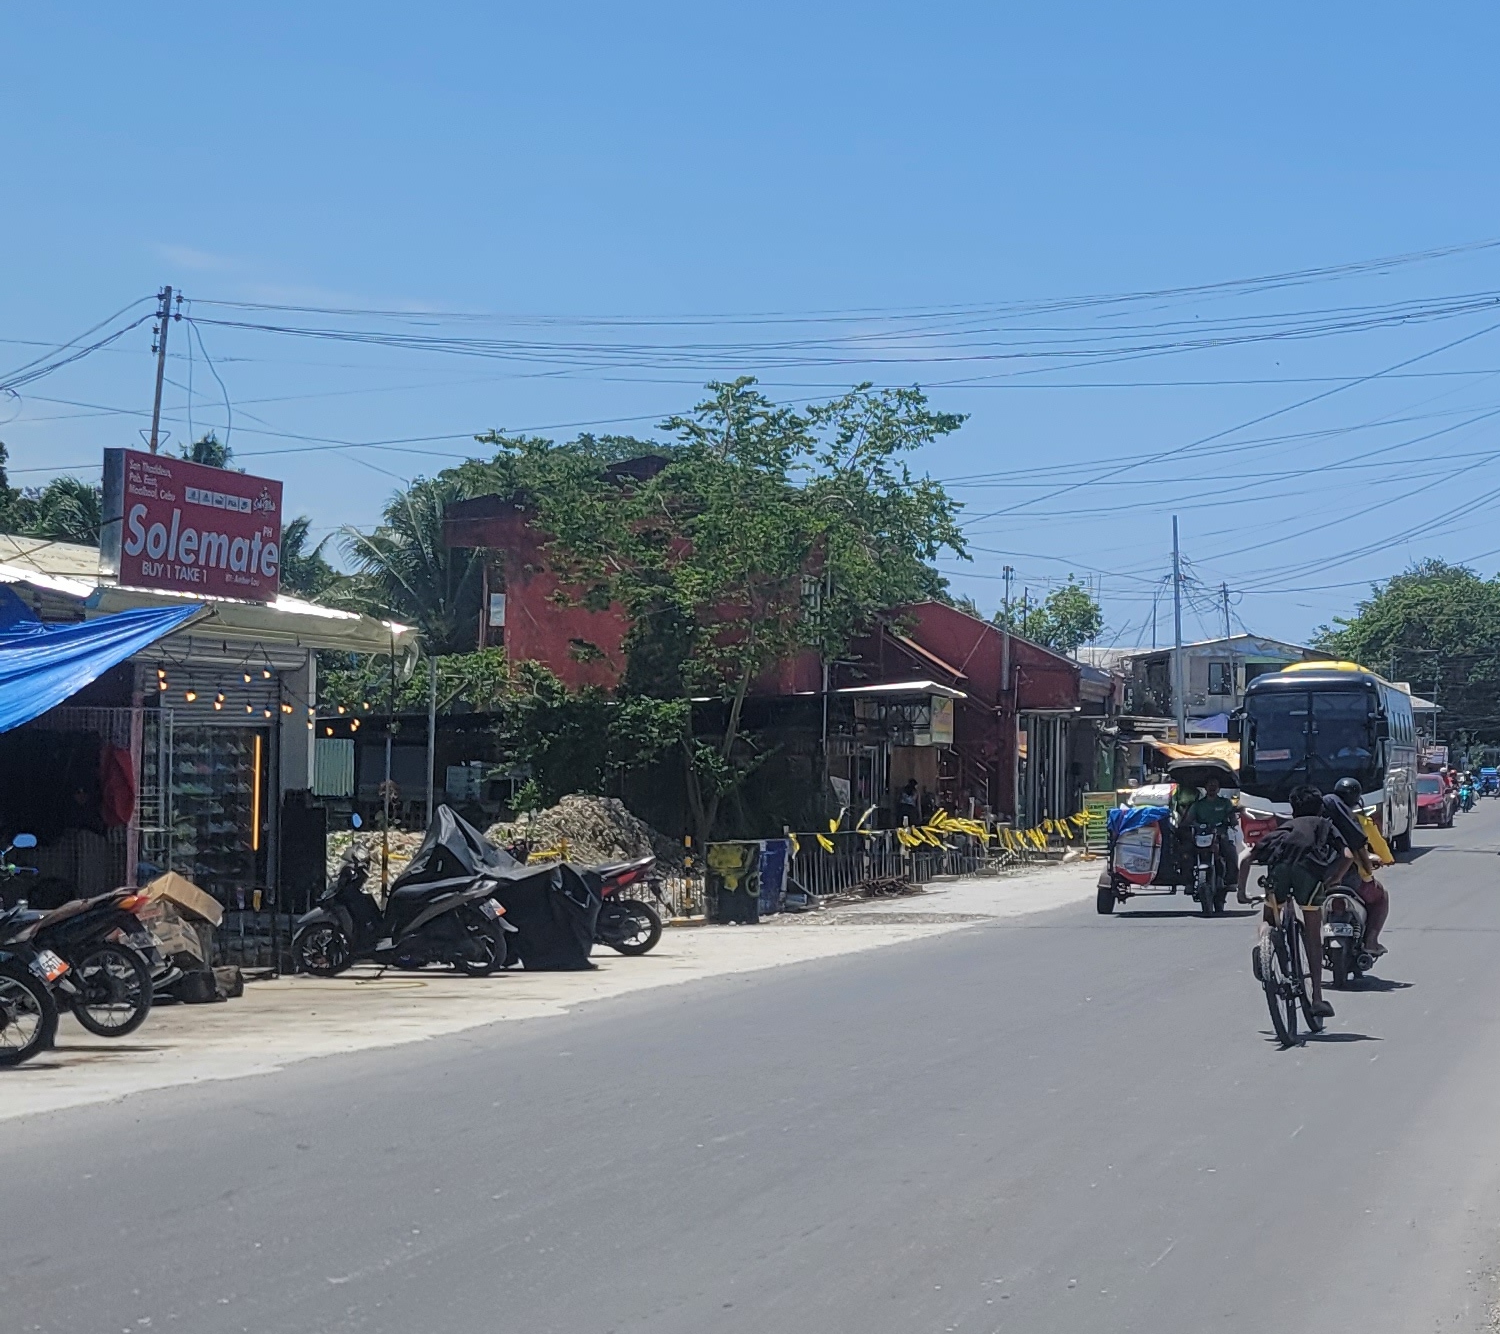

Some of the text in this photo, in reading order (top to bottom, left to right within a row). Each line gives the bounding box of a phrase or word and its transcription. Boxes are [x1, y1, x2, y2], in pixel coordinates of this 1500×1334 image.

[124, 503, 278, 577] Solemate
[142, 561, 207, 584] BUY 1 TAKE 1
